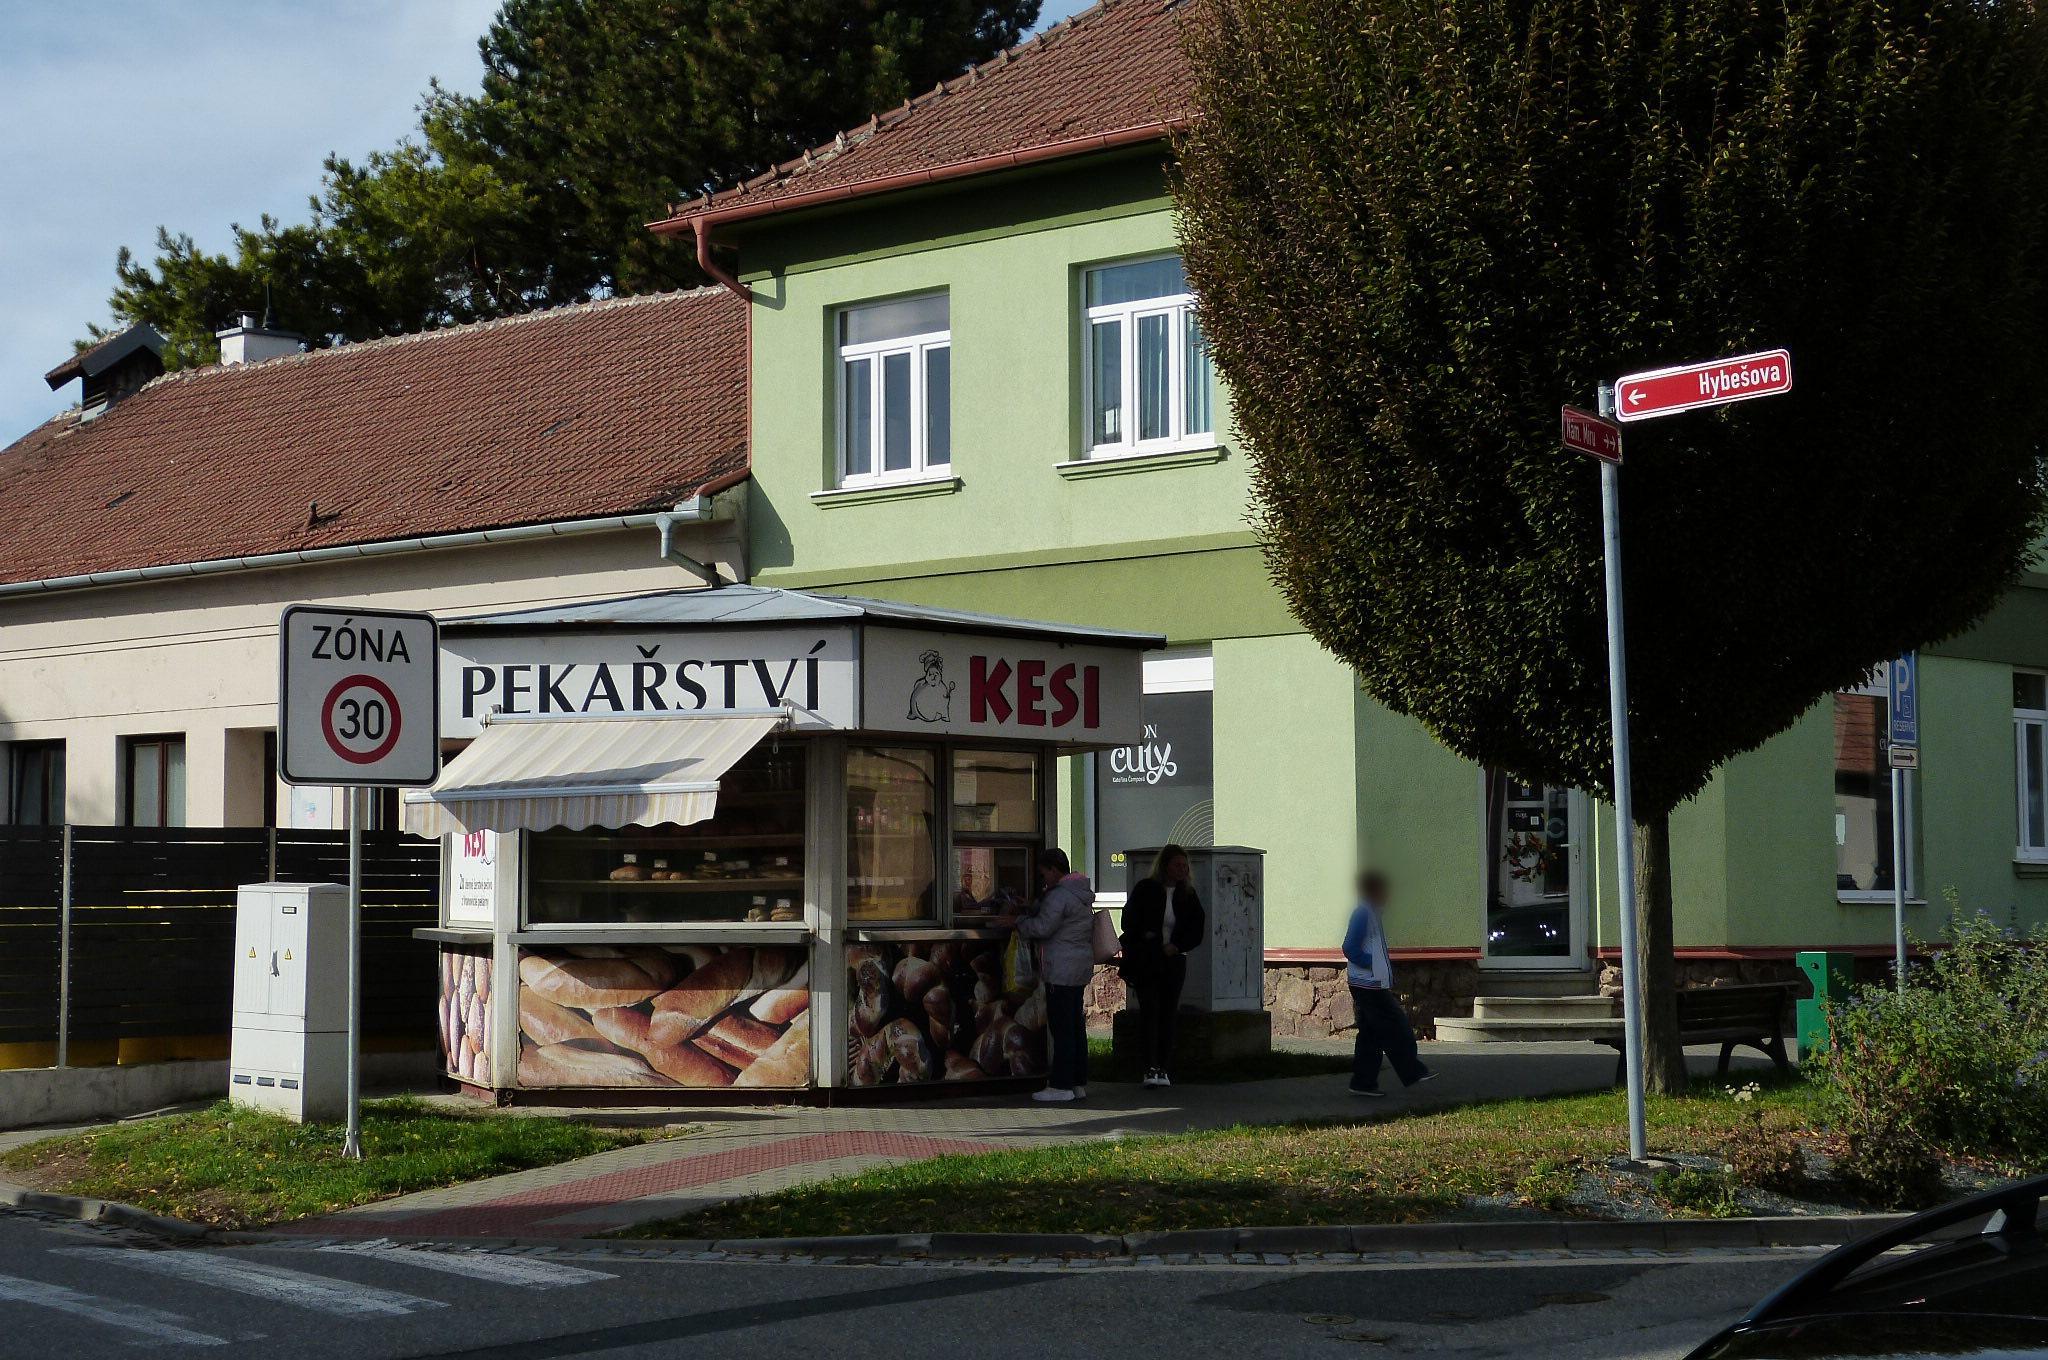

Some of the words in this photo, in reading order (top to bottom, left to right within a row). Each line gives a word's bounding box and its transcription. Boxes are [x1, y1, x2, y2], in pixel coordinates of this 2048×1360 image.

[1699, 364, 1781, 399] Hybešova
[311, 618, 411, 664] ZÓNA
[462, 639, 827, 718] PEKAŘSTVÍ
[969, 655, 1100, 729] KESI
[1895, 658, 1910, 712] P
[339, 698, 385, 741] 30
[1110, 741, 1178, 785] cuty
